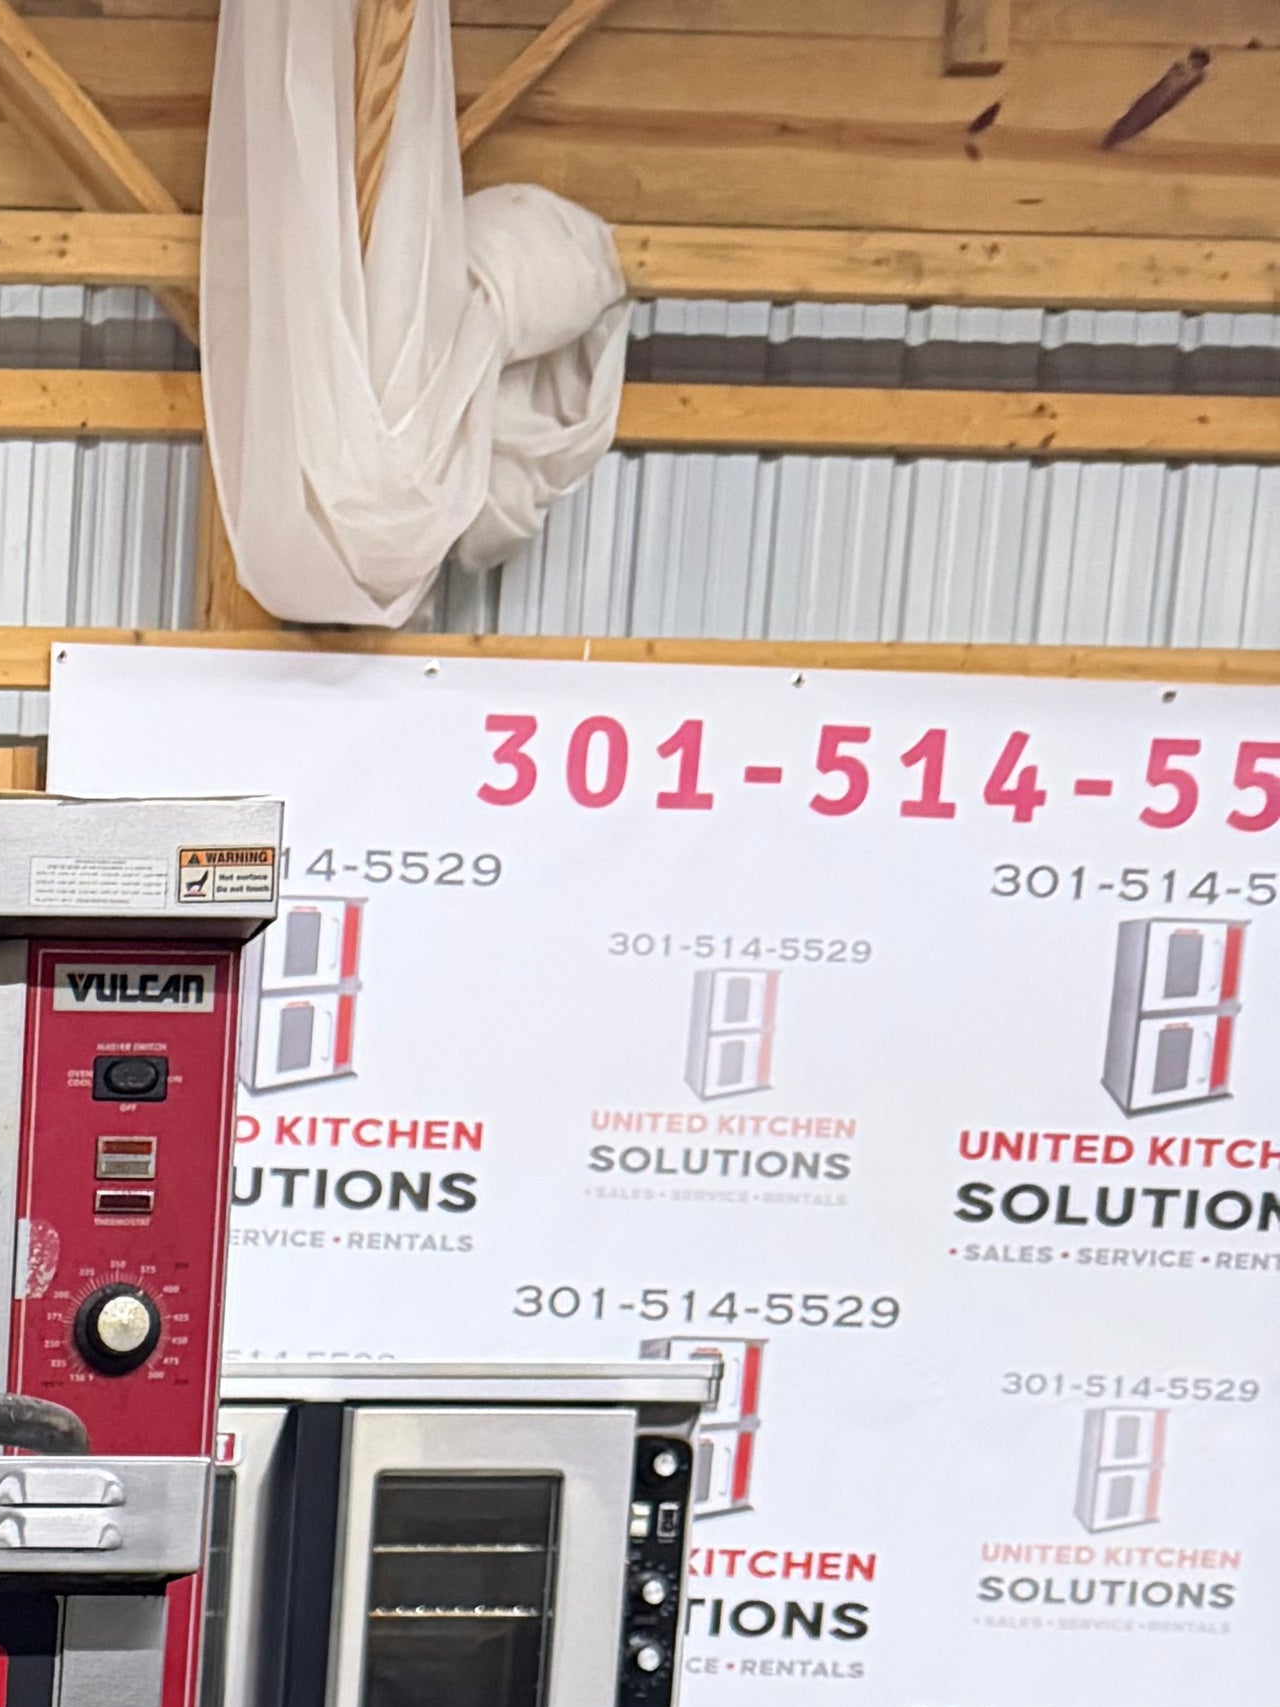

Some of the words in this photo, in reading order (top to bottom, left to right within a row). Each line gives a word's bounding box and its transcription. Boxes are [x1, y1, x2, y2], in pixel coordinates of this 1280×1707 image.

[206, 851, 267, 863] WARNING
[607, 931, 873, 964] 301-514-5529
[67, 973, 205, 1003] VULCAN
[274, 1115, 483, 1151] KITCHEN
[591, 1110, 707, 1134] UNITED
[719, 1113, 856, 1139] KITCHEN
[588, 1145, 852, 1180] SOLUTIONS
[958, 1131, 1135, 1164] UNITED
[347, 1231, 474, 1253] RENTALS
[964, 1244, 1053, 1264] SALES
[1077, 1247, 1194, 1268] SERVICE
[512, 1285, 900, 1329] 301-514-5529
[1002, 1373, 1259, 1402] 301-514-5529
[981, 1543, 1094, 1566] UNITED
[1103, 1546, 1241, 1570] KITCHEN
[977, 1576, 1236, 1610] SOLUTIONS
